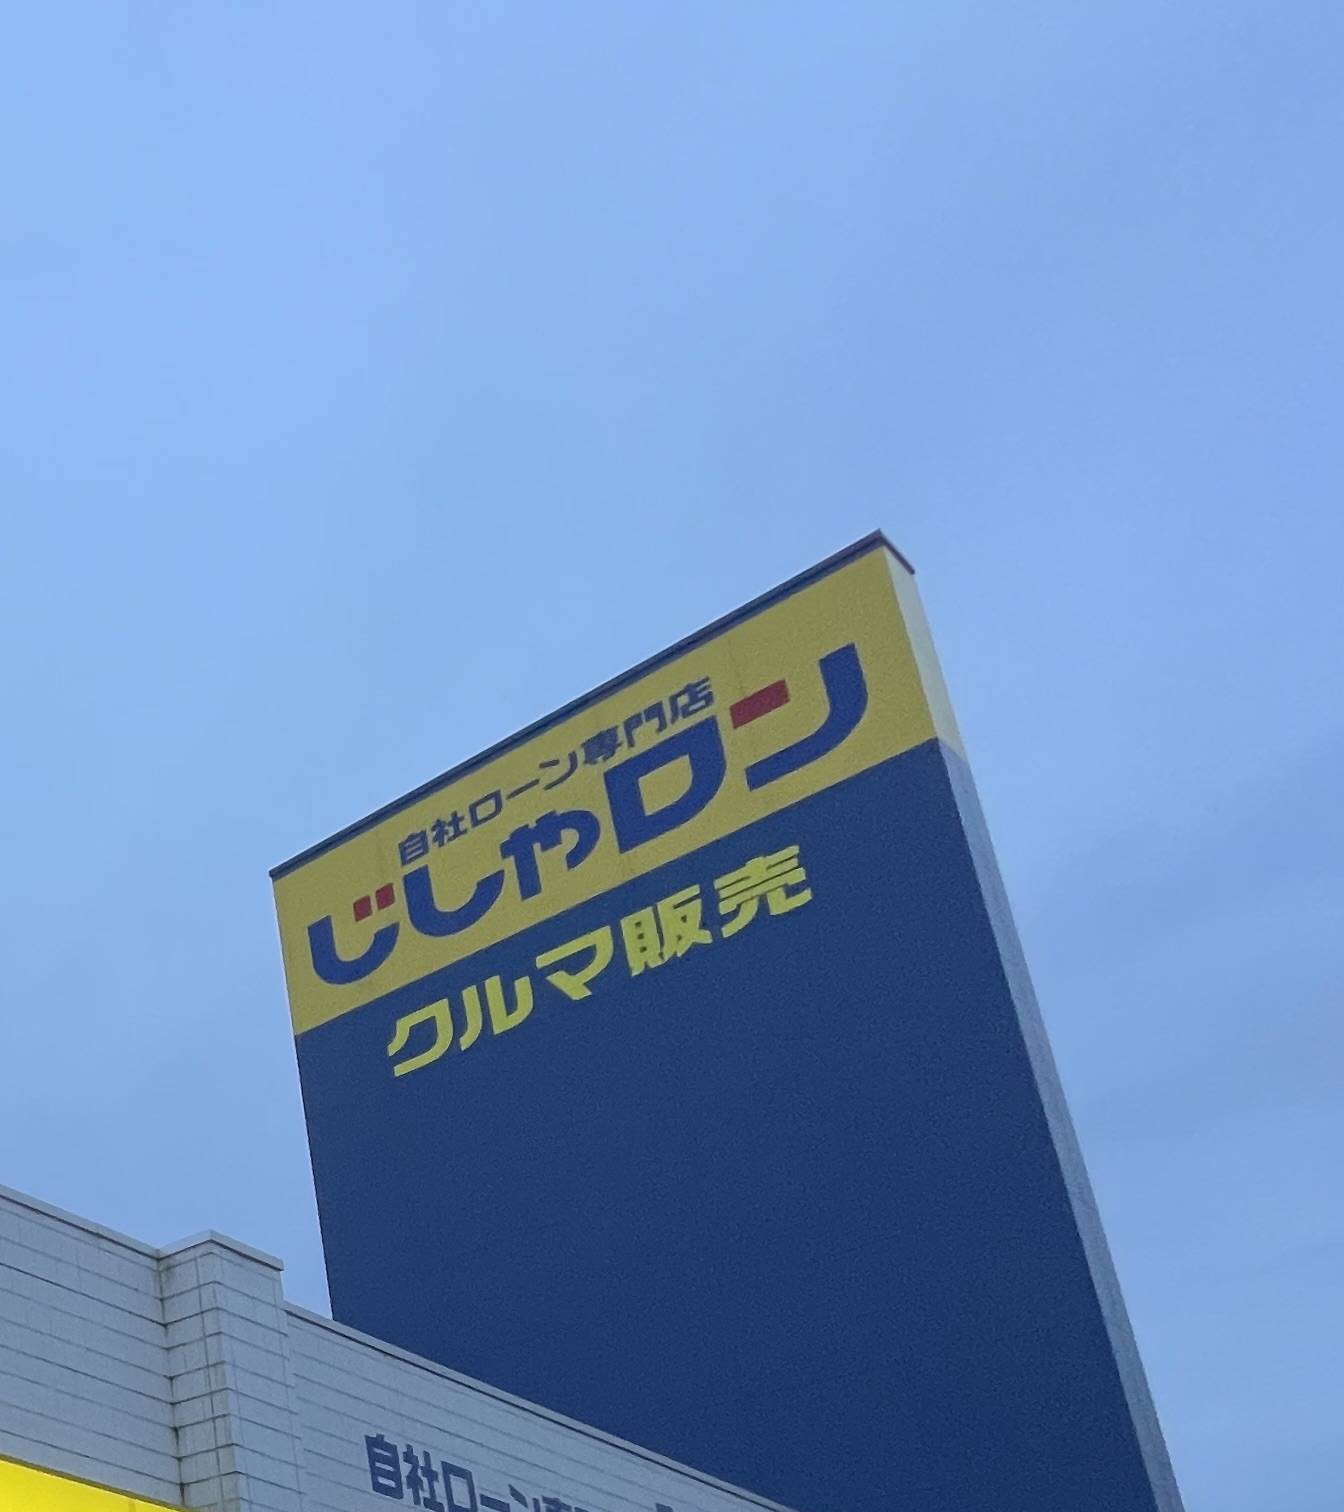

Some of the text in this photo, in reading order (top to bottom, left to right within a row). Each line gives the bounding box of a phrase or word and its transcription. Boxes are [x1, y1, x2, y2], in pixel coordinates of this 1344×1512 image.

[399, 676, 715, 867] 自社ローン専門店
[387, 844, 812, 1077] クルマ販売
